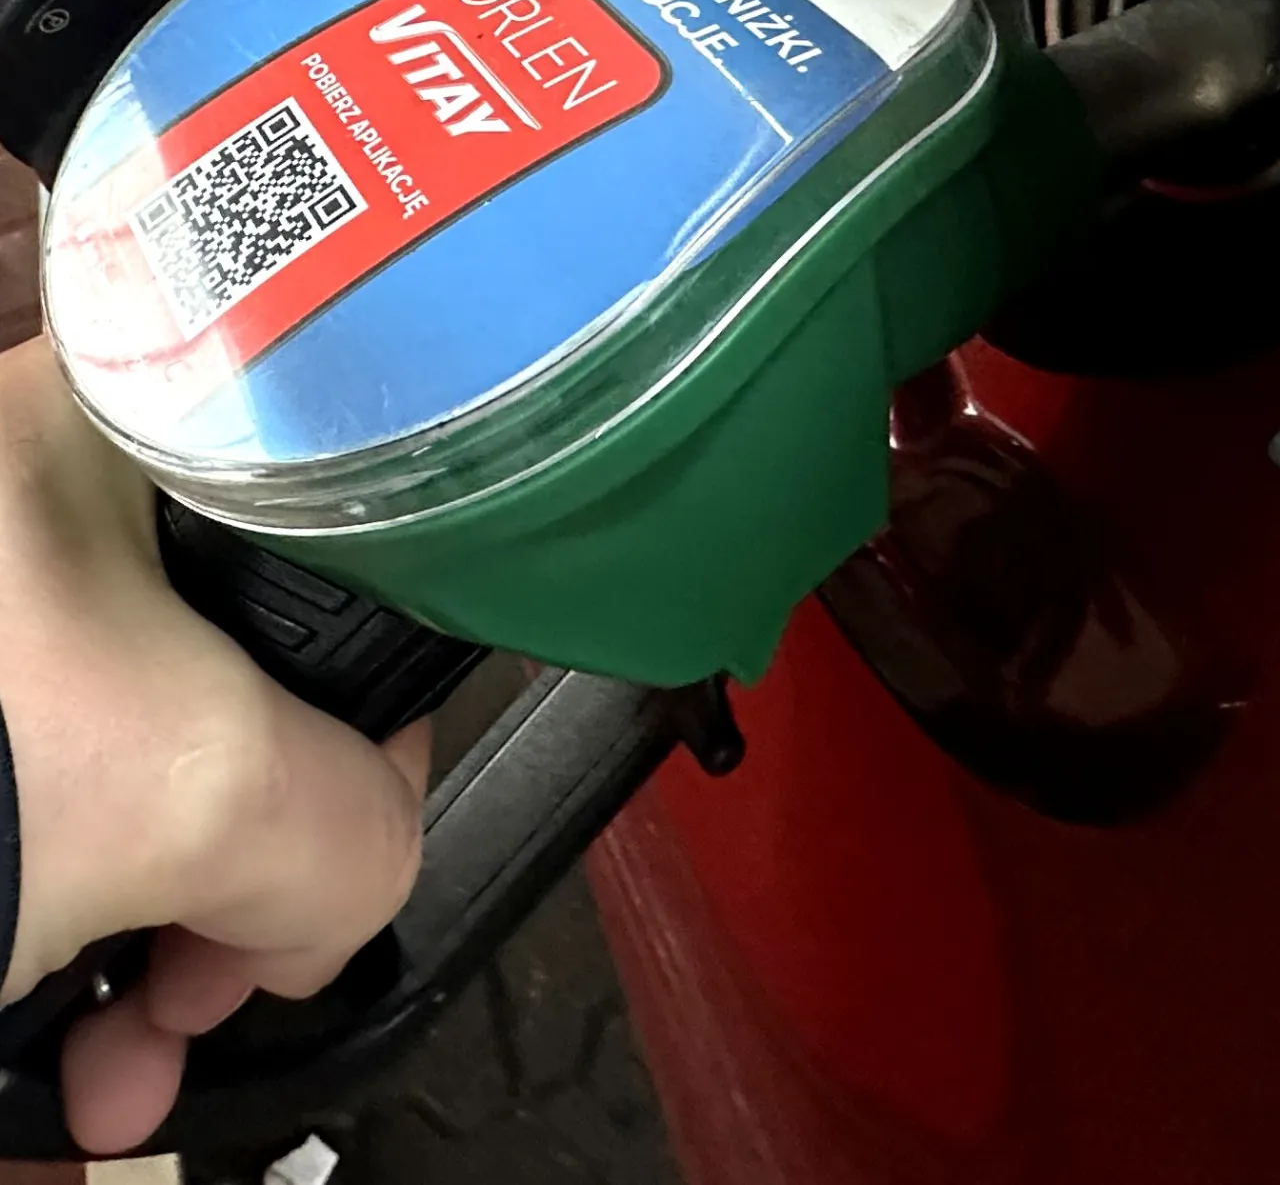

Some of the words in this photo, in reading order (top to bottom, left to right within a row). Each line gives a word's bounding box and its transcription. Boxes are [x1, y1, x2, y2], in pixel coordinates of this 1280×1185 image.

[300, 52, 363, 124] POBIERZ
[346, 119, 431, 220] APLIKACJĘ
[369, 4, 541, 136] VITAY
